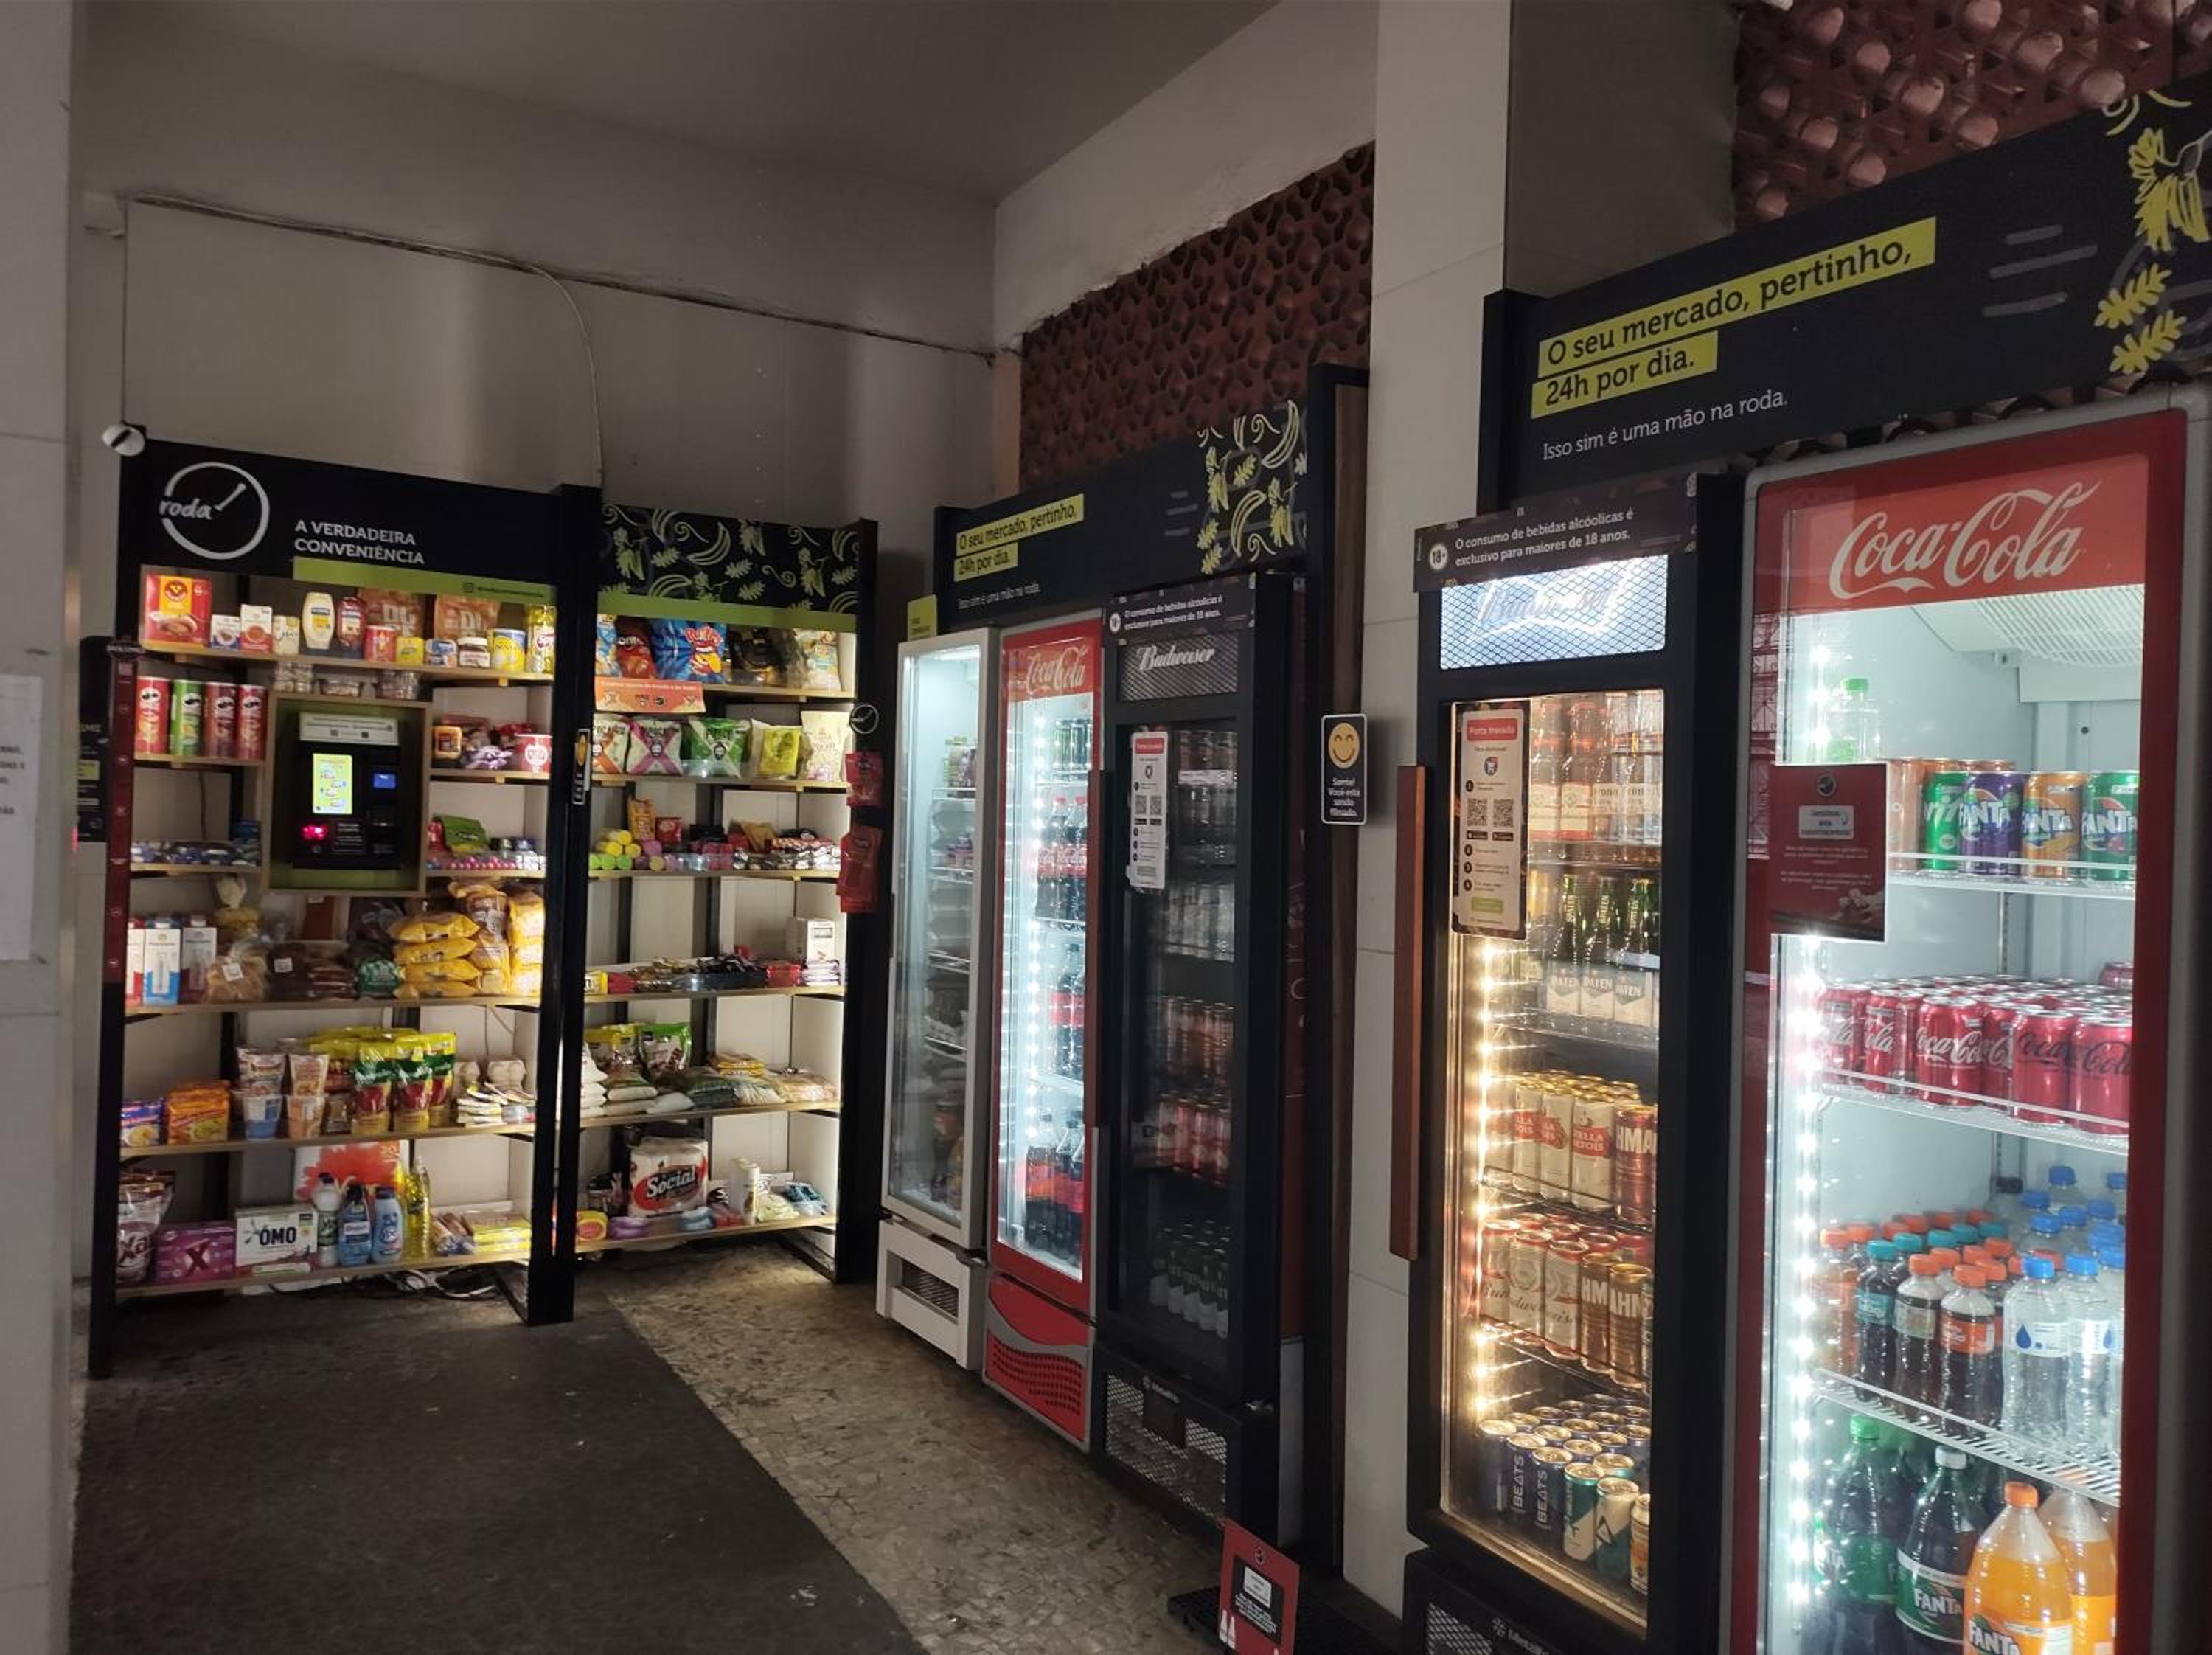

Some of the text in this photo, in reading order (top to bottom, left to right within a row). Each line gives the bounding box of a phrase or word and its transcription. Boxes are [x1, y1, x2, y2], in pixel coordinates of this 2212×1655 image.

[1548, 240, 1912, 365] O seu mercado, pertinho,
[1545, 347, 1694, 406] 24h por dia.
[1543, 389, 1788, 461] Isso sim é uma mão na roda.
[159, 497, 212, 521] roda
[959, 502, 1078, 548] O seu mercado, pertinho,
[1455, 507, 1634, 550] O consumo de bebidas alcoólicas é
[295, 519, 416, 545] A VERDADEIRA
[295, 538, 425, 564] CONVENIÊNCIA
[1455, 529, 1631, 567] exclusivo para maiores de 18 anos.
[1829, 479, 2101, 599] Coca-Cola
[959, 548, 1010, 575] 24h por dia.
[1136, 644, 1215, 670] Budweiser
[646, 1164, 697, 1198] Social
[1512, 1454, 1524, 1507] BEATS
[1537, 1469, 1548, 1523] BEATS
[1914, 1588, 1963, 1614] FANTA
